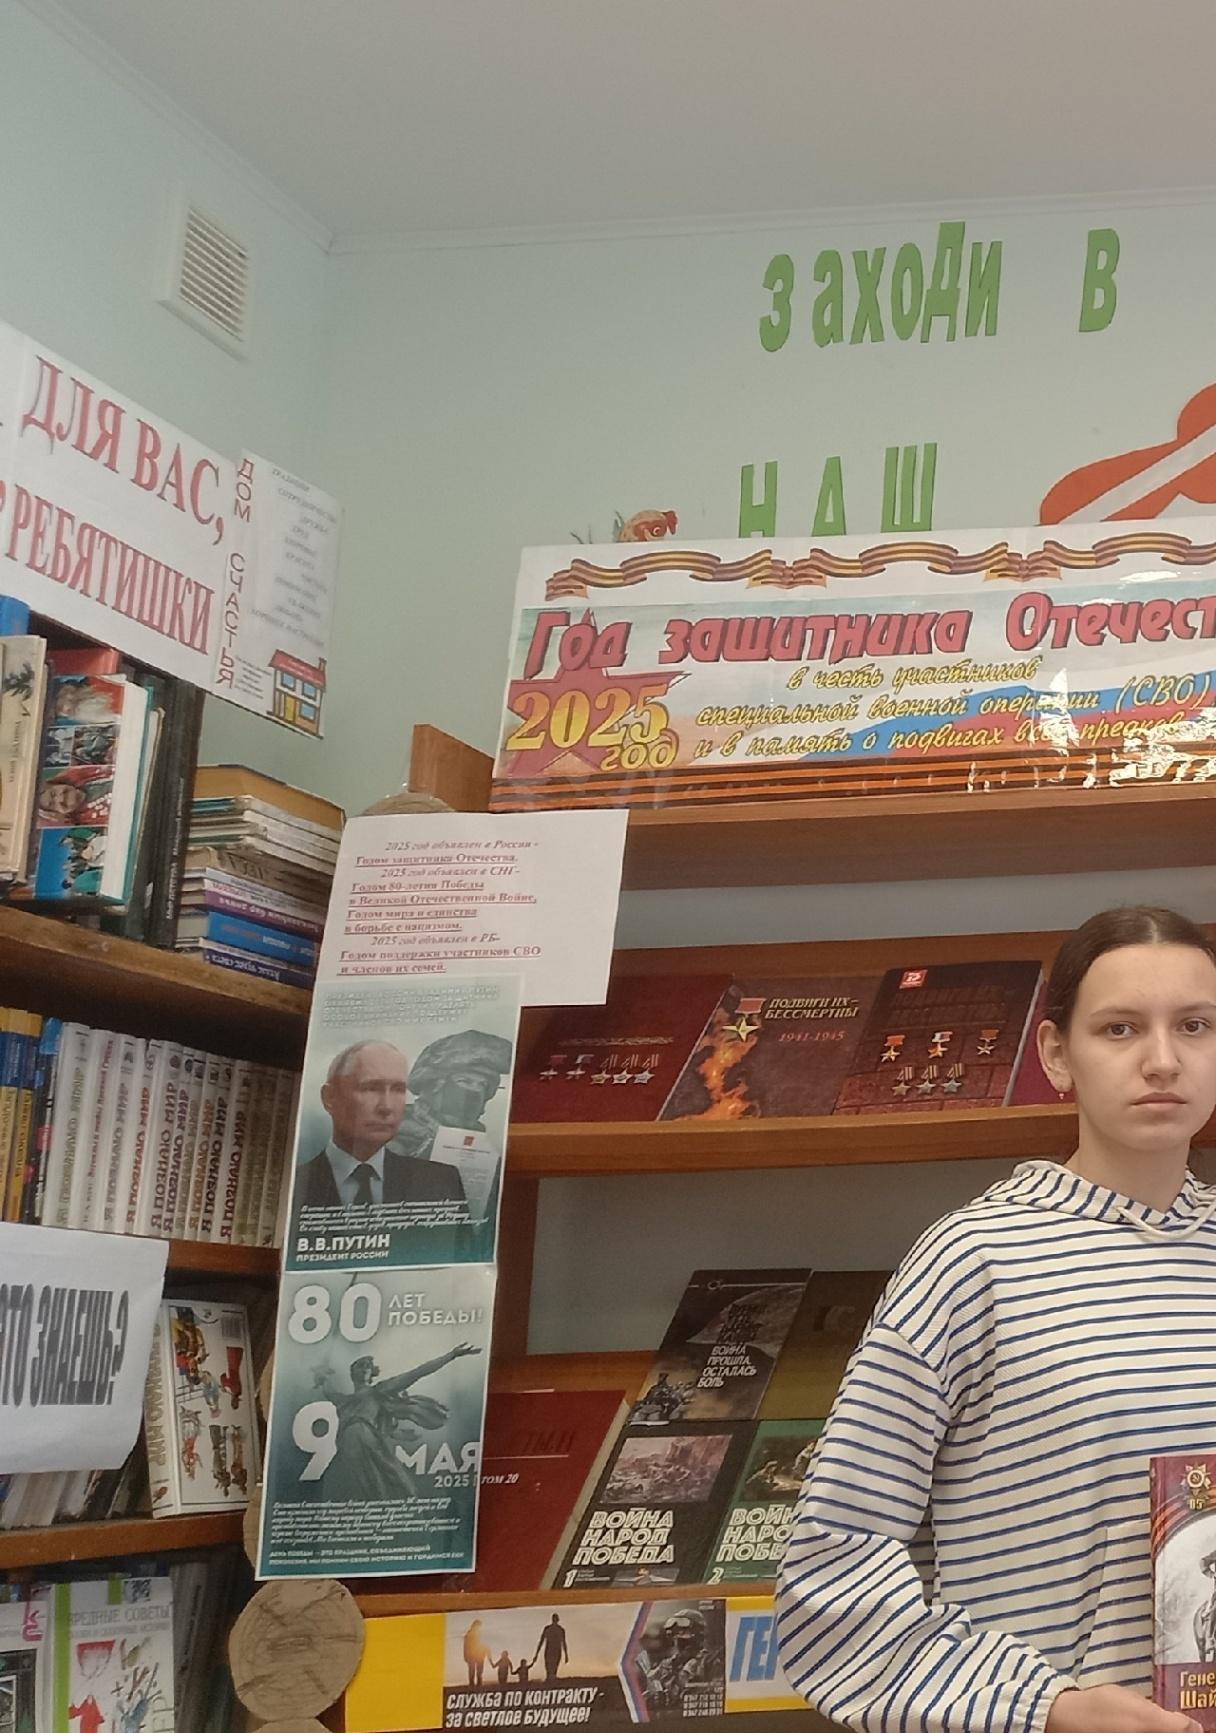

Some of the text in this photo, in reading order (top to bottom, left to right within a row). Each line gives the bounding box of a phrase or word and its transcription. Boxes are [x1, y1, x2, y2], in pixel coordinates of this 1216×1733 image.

[20, 355, 126, 474] ДЛЯ
[130, 418, 224, 546] ВАС,
[234, 458, 254, 523] ДОМ
[5, 483, 215, 656] РЕБЯТИШКИ
[216, 553, 245, 689] СЧАСТЬЯ
[523, 609, 633, 681] Год
[786, 655, 1043, 692] в честь участников
[695, 695, 860, 729] специальной
[867, 687, 974, 718] военной
[1114, 673, 1213, 713] (СВО)
[507, 684, 670, 751] 2025
[694, 736, 713, 758] и
[720, 731, 742, 757] в
[745, 726, 852, 758] память
[862, 733, 877, 751] о
[887, 721, 1004, 751] подвигах
[513, 946, 541, 956] СВО
[765, 1006, 859, 1020] БЕССМЕРТНЫ
[769, 998, 827, 1009] ПОДВИГИ
[778, 1030, 846, 1042] 1941-1945
[153, 1129, 171, 1210] ПОЗНАЮ
[164, 1081, 180, 1124] МИР
[297, 1233, 391, 1253] В.В.ПУТИН
[296, 1250, 389, 1262] ПРЕЗИДЕНТ РОССИИ
[389, 1293, 426, 1309] ЛЕТ
[287, 1283, 382, 1344] 80
[388, 1308, 483, 1327] ПОБЕДЫ!
[703, 1365, 757, 1377] ОСТАЛАСЬ
[697, 1377, 724, 1388] БОЛЬ
[292, 1400, 340, 1481] 9
[395, 1441, 480, 1475] МАЯ
[434, 1474, 470, 1488] 2025
[588, 1507, 674, 1529] ВОЙНА
[580, 1527, 672, 1547] НАРОД
[571, 1544, 675, 1567] ПОБЕДА
[562, 1568, 578, 1589] 1
[706, 1566, 726, 1585] 2
